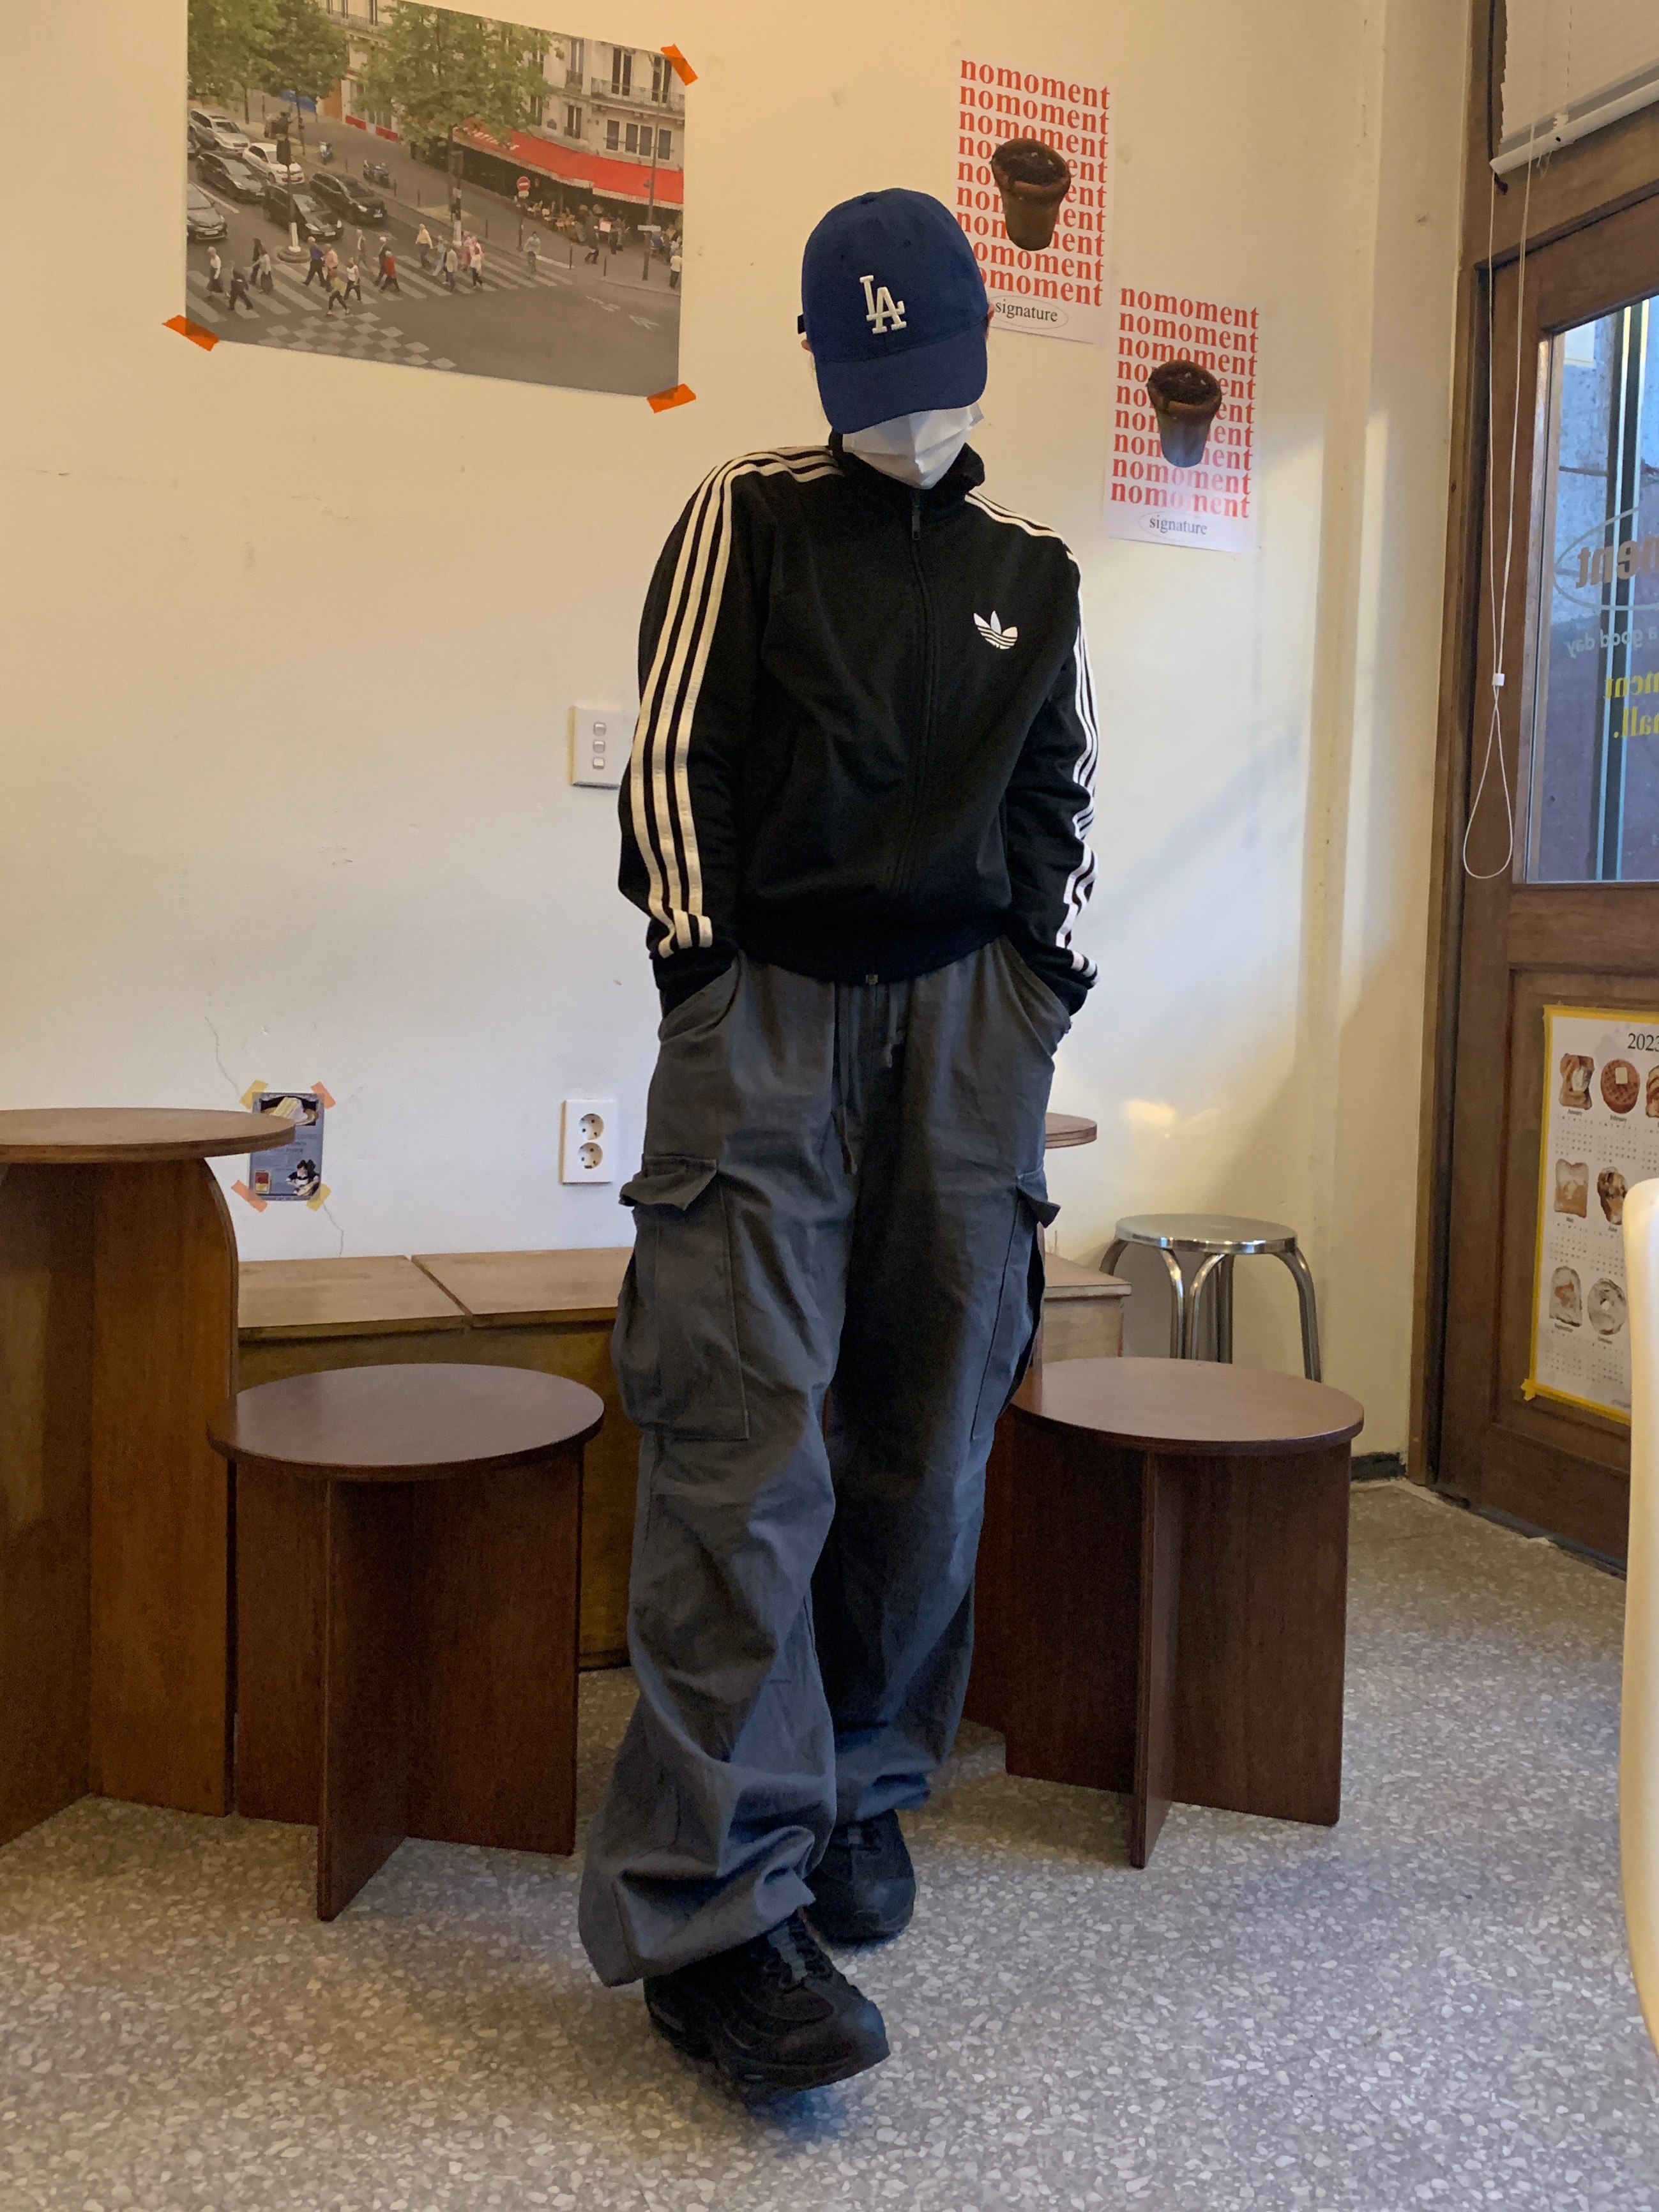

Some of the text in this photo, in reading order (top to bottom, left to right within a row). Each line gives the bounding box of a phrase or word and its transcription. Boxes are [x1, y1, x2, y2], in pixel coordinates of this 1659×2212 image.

[960, 59, 1110, 110] nomoment
[960, 85, 1110, 135] nomoment
[958, 110, 1109, 160] nomoment
[958, 135, 1108, 183] noent
[957, 160, 1107, 208] noent
[973, 241, 1104, 282] omoment
[860, 275, 907, 335] LA
[995, 299, 1058, 323] signature
[1120, 287, 1259, 330] nomoment
[1119, 312, 1259, 354] nomoment
[1117, 336, 1257, 377] nomoment
[1117, 360, 1256, 401] noent
[1116, 384, 1255, 425] noent
[1112, 458, 1252, 496] nomoment
[1149, 514, 1208, 536] signature
